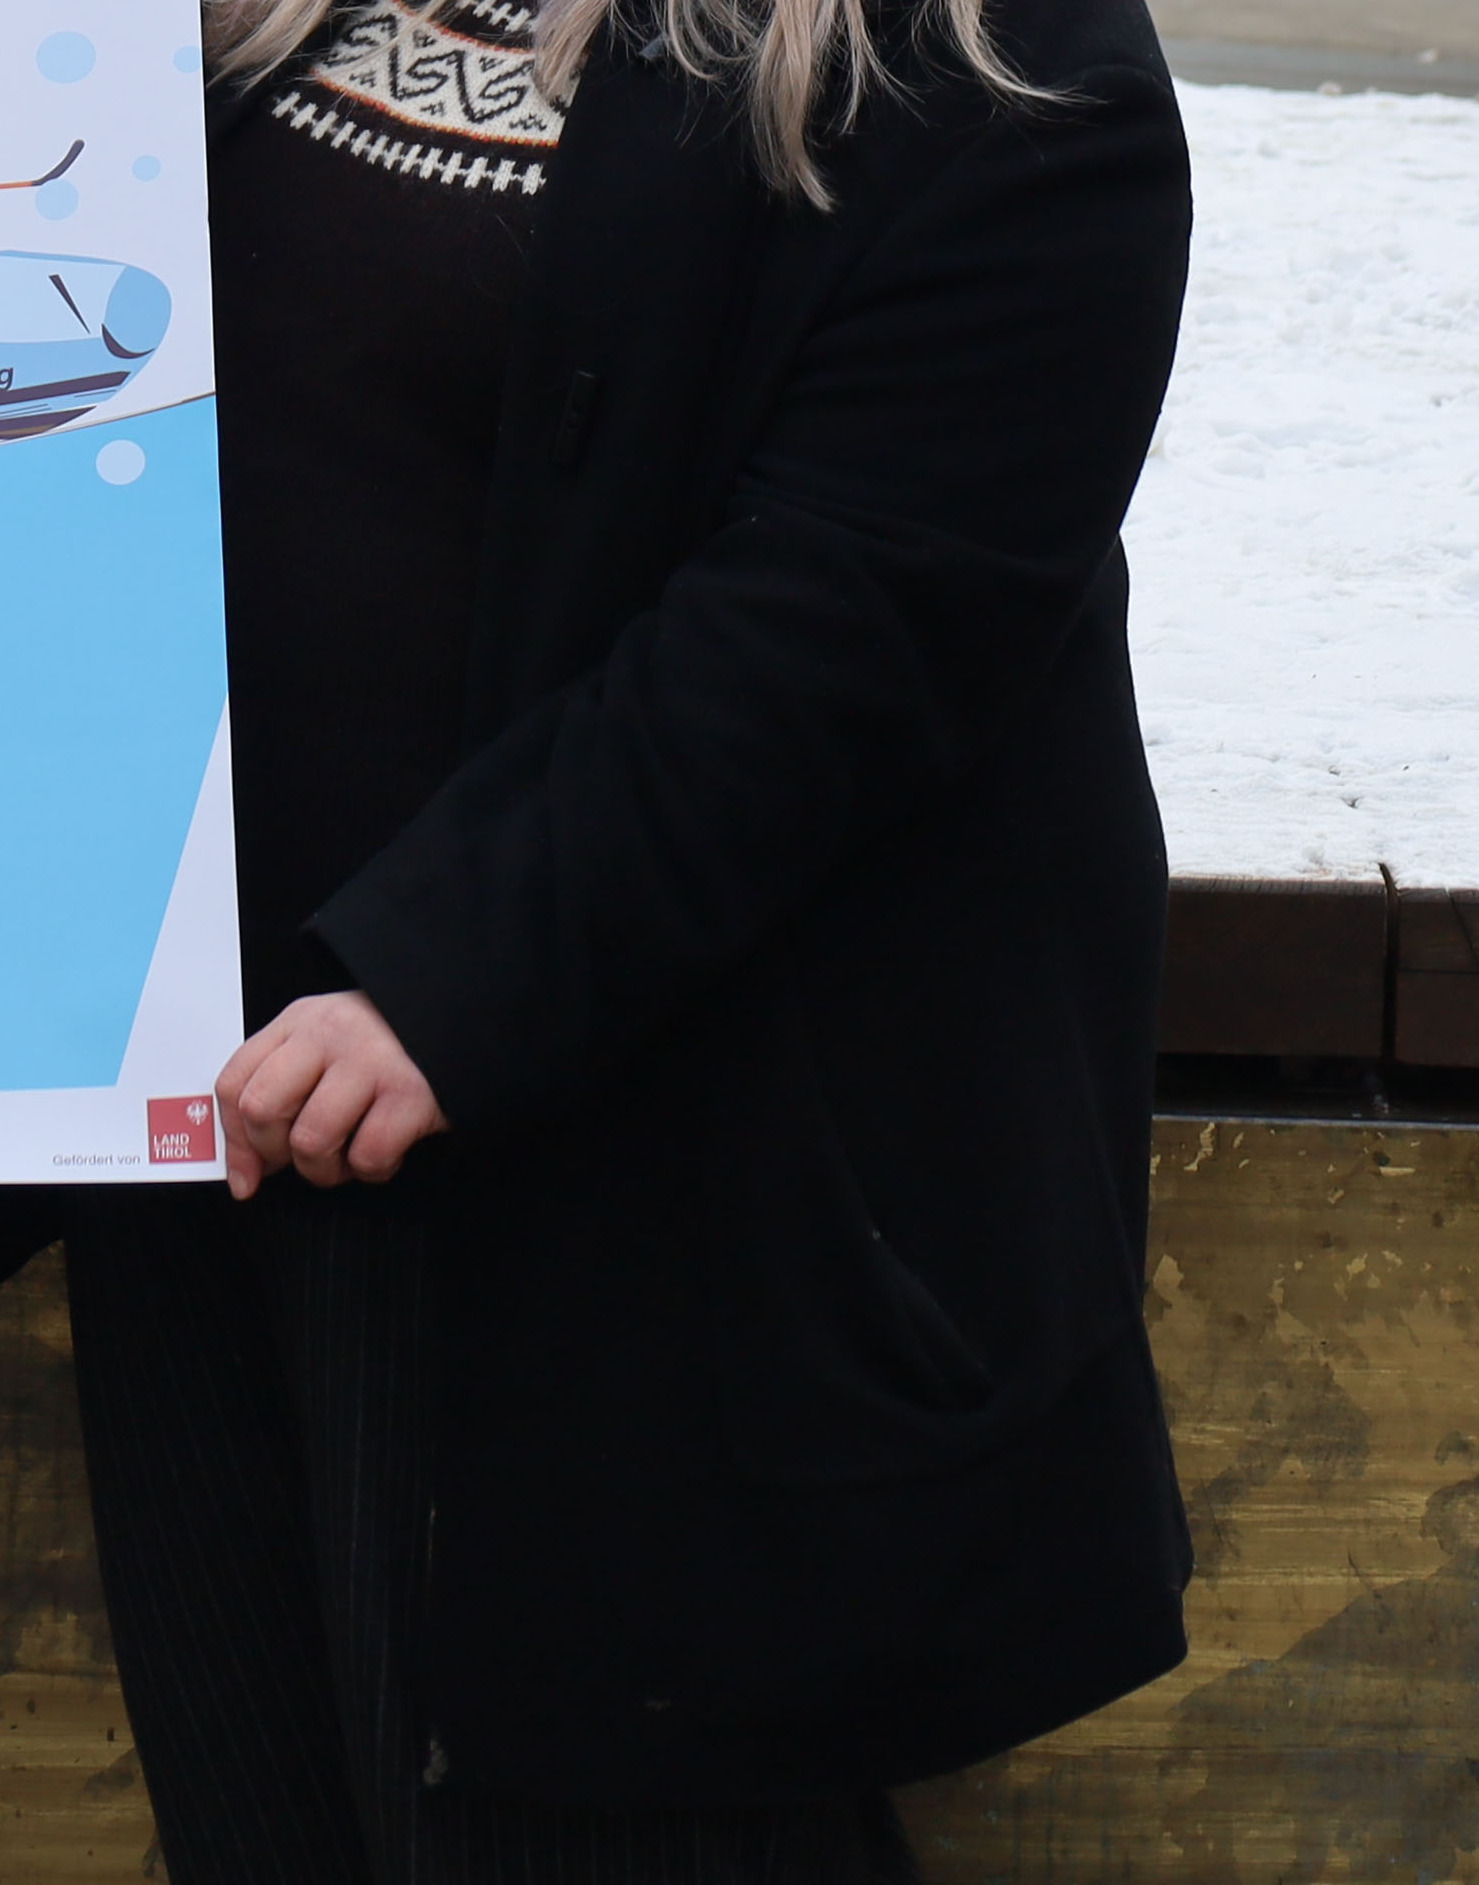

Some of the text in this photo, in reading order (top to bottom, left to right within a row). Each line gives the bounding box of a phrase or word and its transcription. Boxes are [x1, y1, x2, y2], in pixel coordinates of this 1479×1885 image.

[153, 1133, 190, 1146] LAND
[154, 1146, 191, 1159] TIROL
[52, 1154, 140, 1166] Gefördert von
